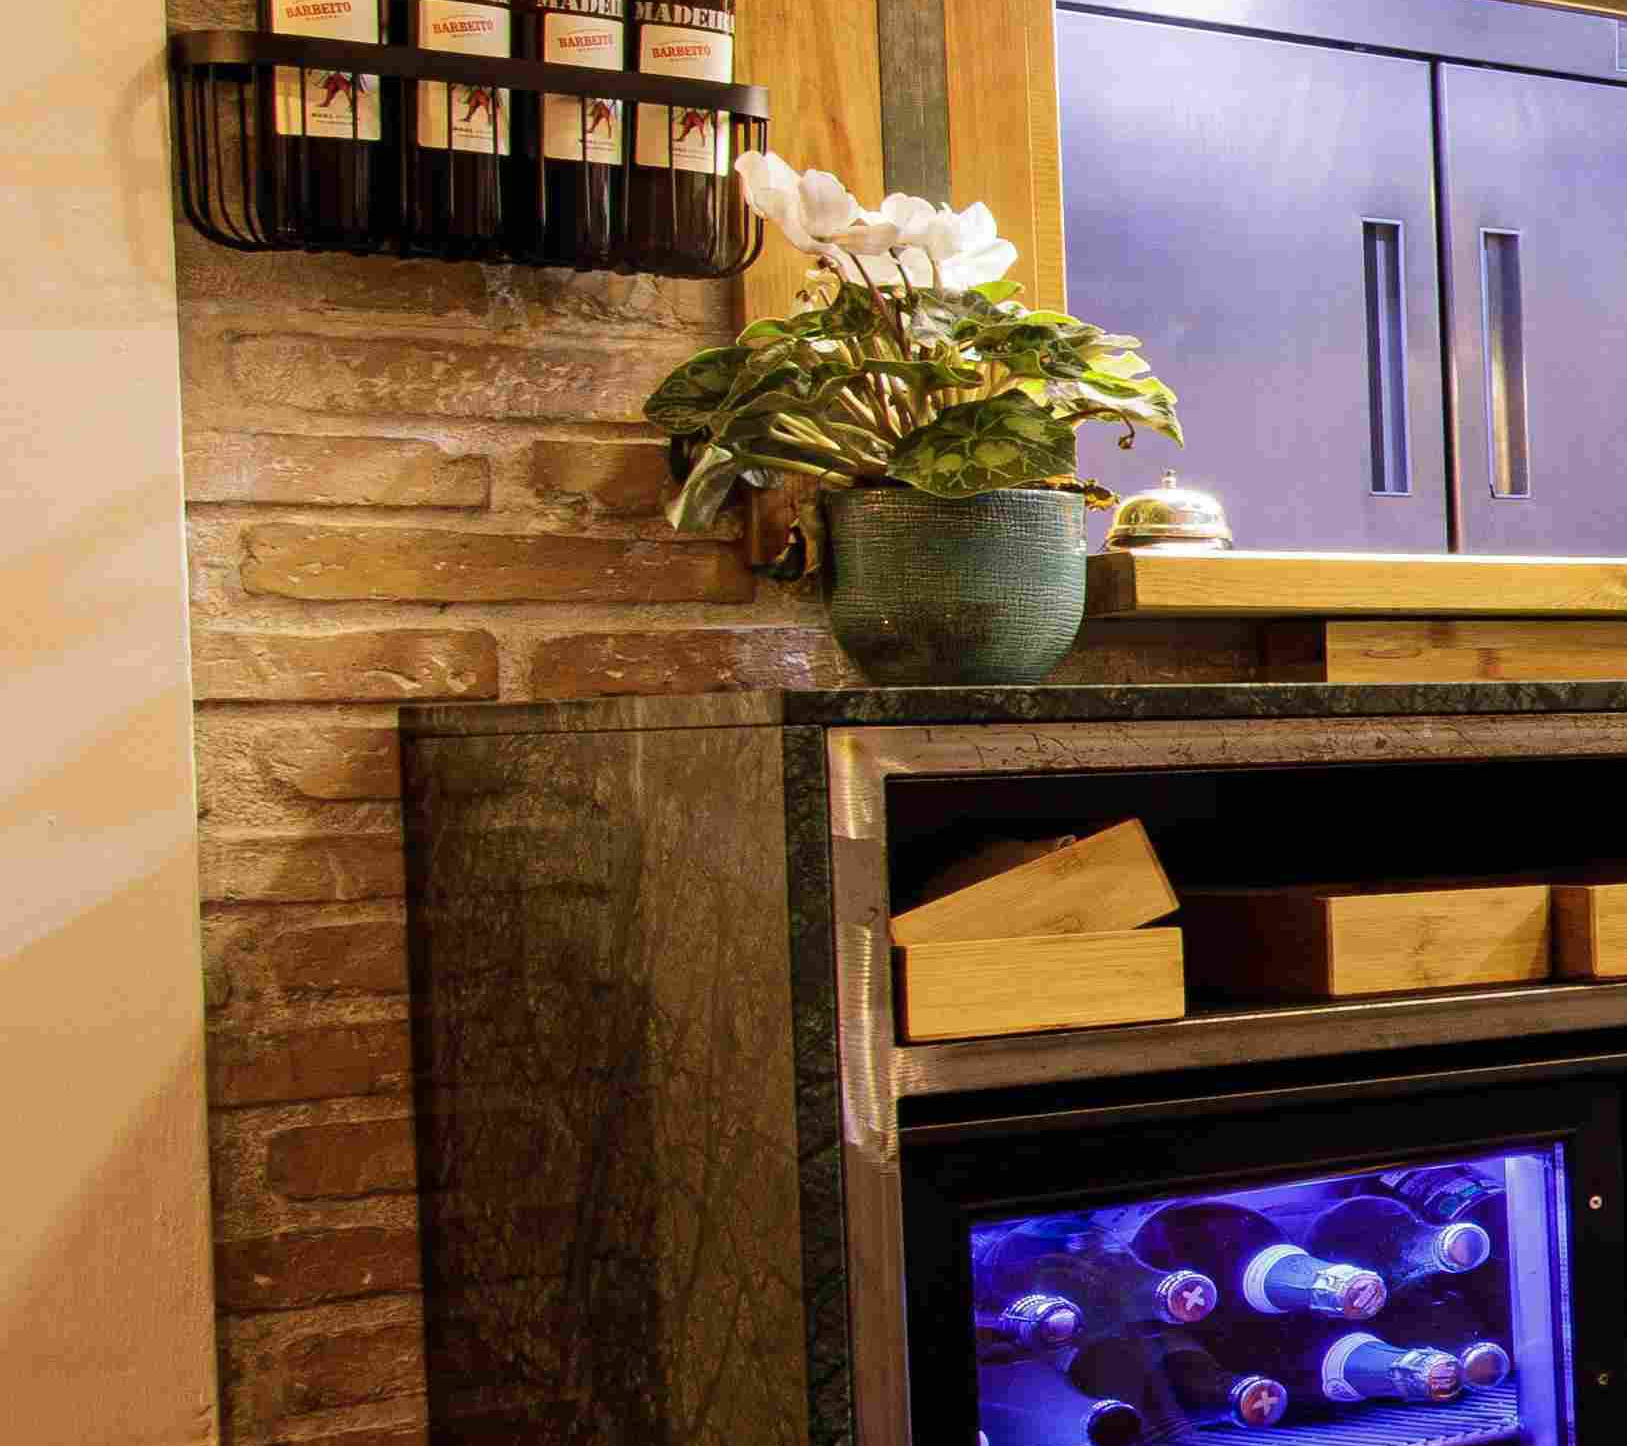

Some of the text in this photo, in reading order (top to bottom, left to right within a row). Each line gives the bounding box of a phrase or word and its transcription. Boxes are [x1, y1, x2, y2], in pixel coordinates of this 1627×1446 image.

[284, 1, 352, 19] BARBEITO
[431, 17, 495, 36] BARBEITO
[558, 33, 613, 49] BARBEITO
[651, 42, 712, 59] BARBEITO
